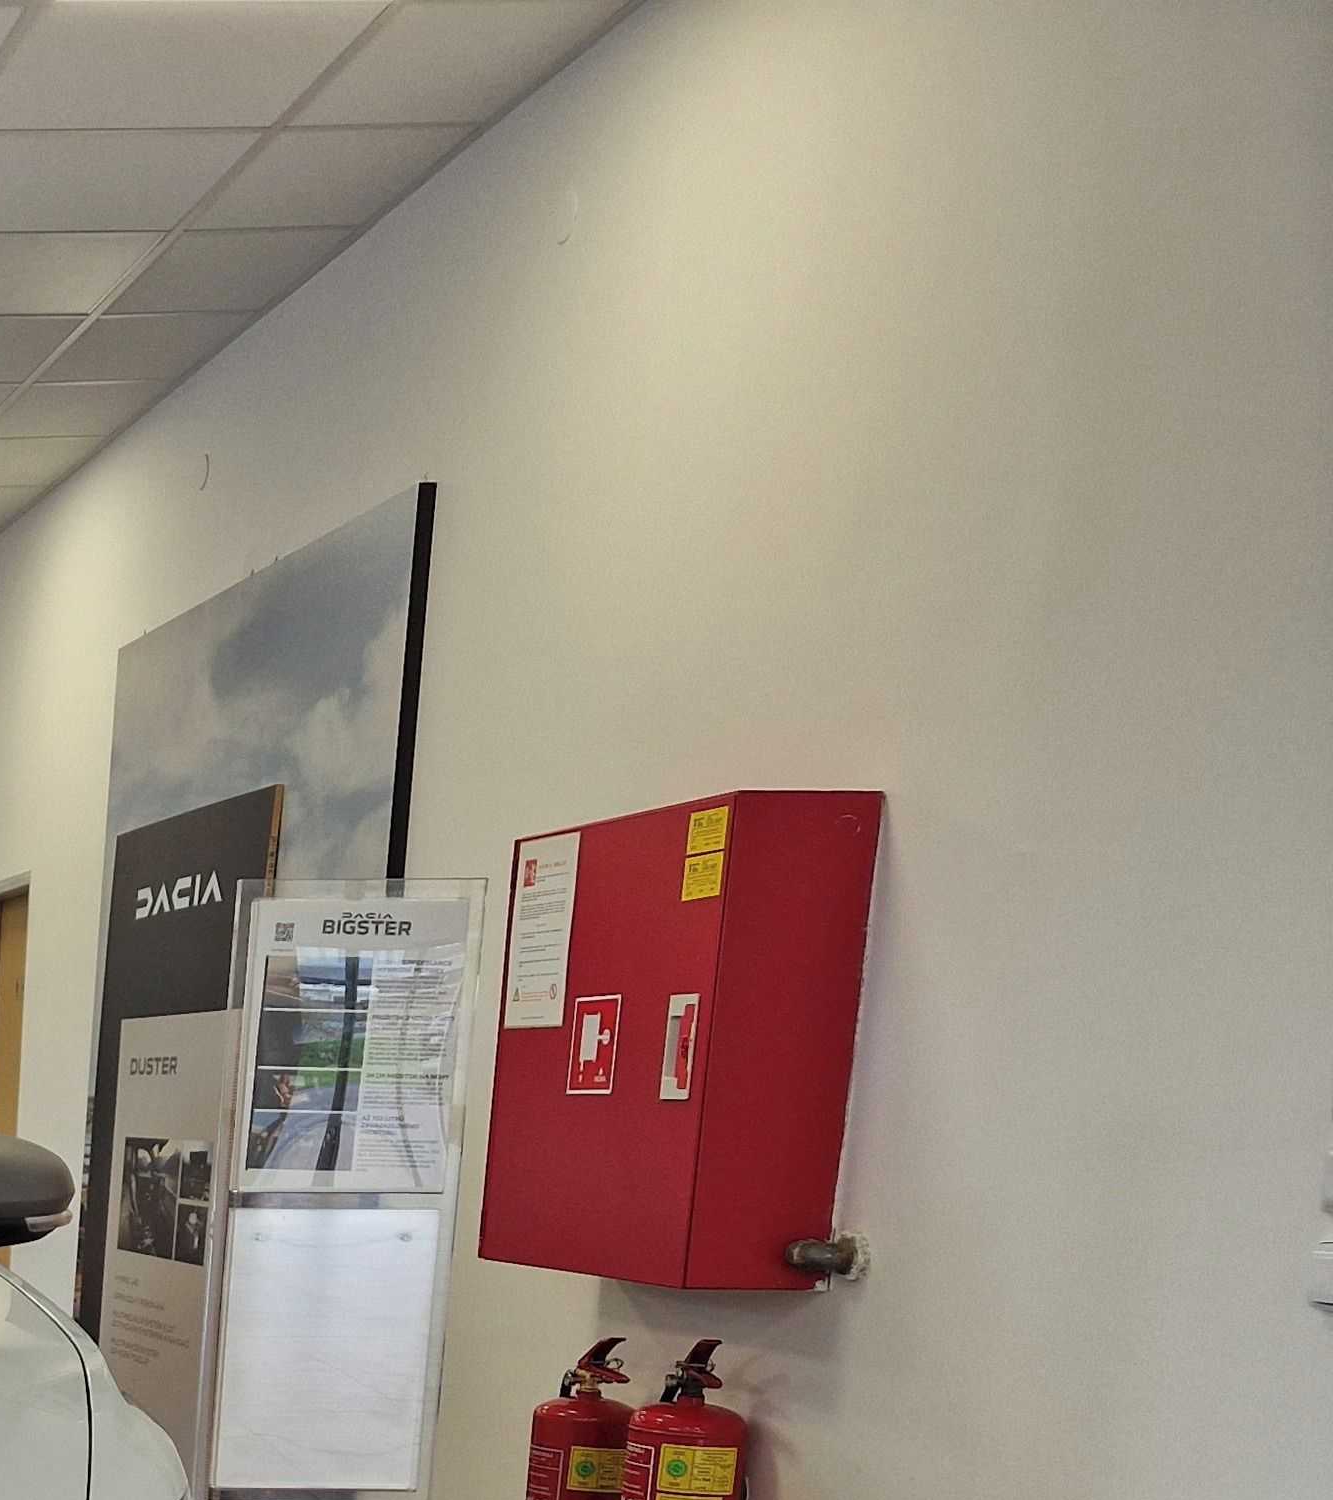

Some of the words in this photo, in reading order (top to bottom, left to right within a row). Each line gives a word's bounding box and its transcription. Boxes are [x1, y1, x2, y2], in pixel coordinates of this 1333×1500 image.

[135, 870, 223, 920] DACIA
[341, 911, 393, 920] DACIA
[321, 919, 412, 936] BIGSTER
[129, 1055, 178, 1076] DUSTER
